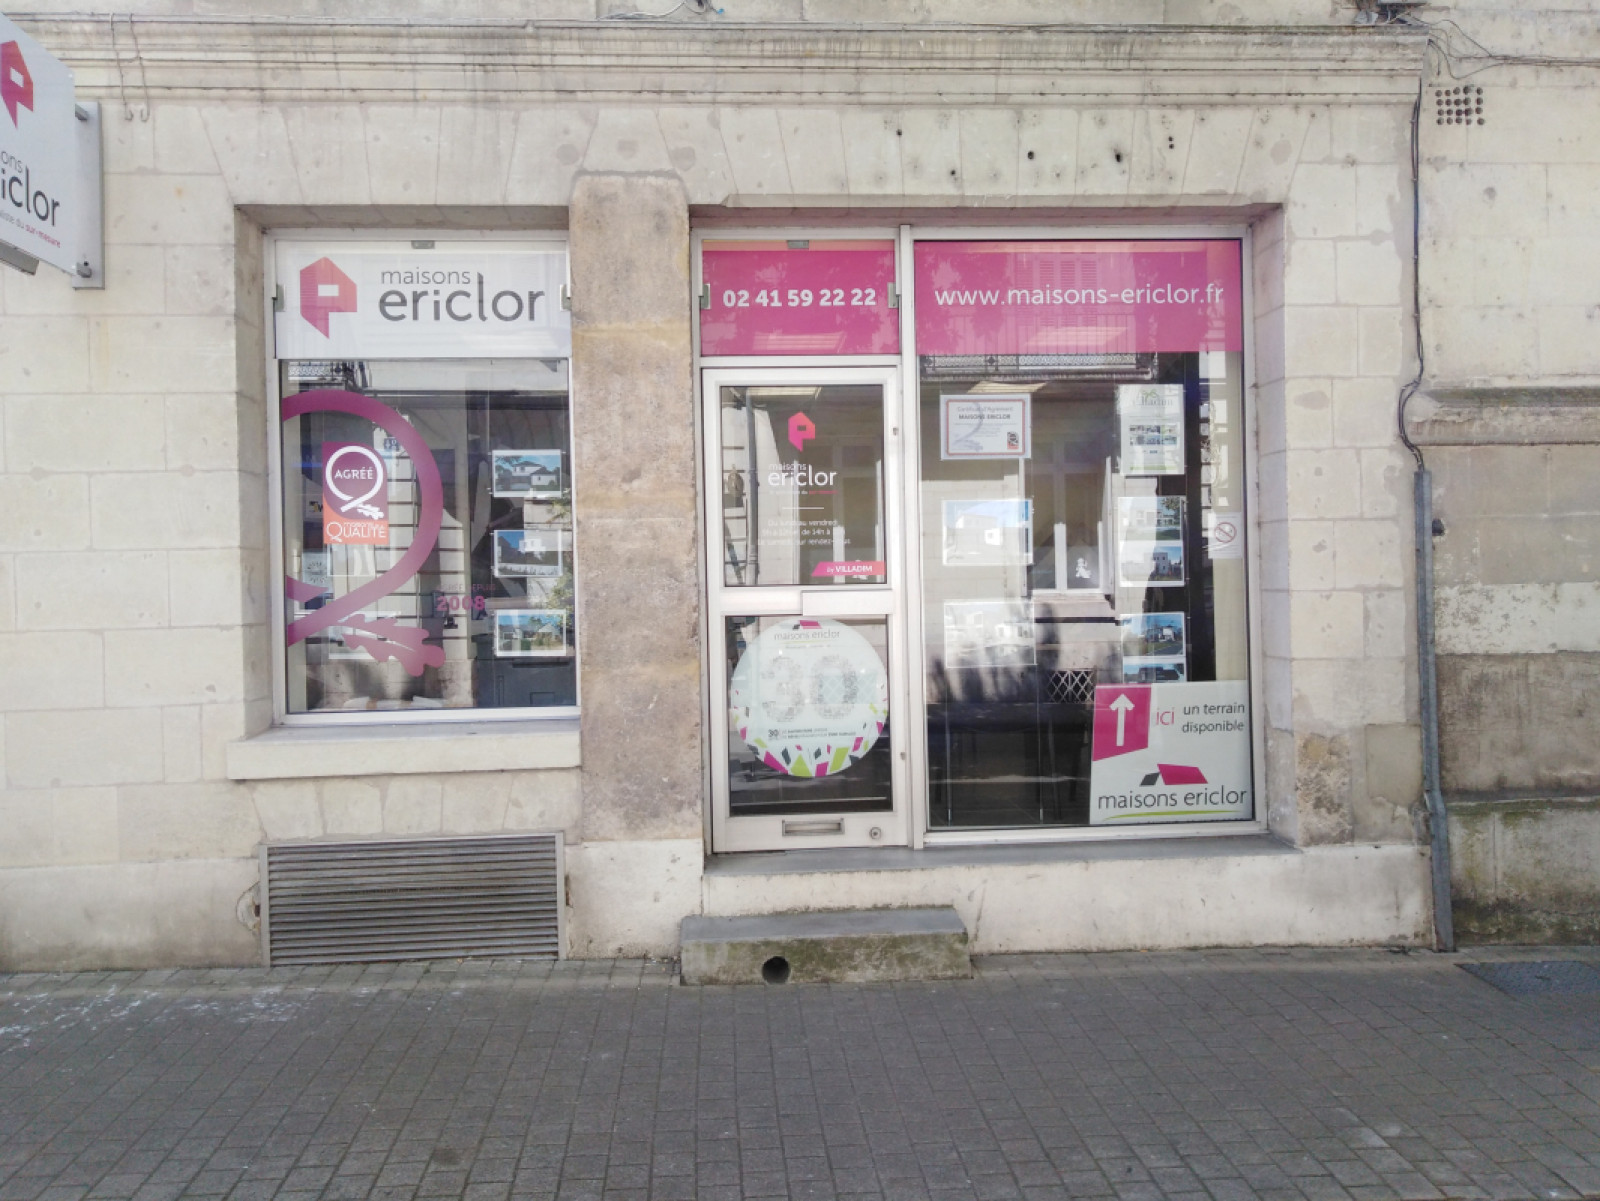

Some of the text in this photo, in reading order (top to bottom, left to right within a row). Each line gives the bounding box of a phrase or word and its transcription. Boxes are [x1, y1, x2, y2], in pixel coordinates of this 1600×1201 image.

[381, 267, 471, 285] maisons
[378, 272, 545, 322] ericlor
[722, 288, 876, 307] 02 41 59 22 22
[934, 283, 1224, 305] www.maisons-ericlor.fr
[334, 466, 374, 480] AGRÉÉ
[767, 464, 837, 486] ericlor
[836, 565, 873, 573] VILLADIM
[436, 595, 485, 612] 2008
[1156, 707, 1175, 726] ici
[1183, 702, 1245, 716] un terrain
[1182, 720, 1245, 735] disponible
[1098, 785, 1247, 809] maisons ericlor
